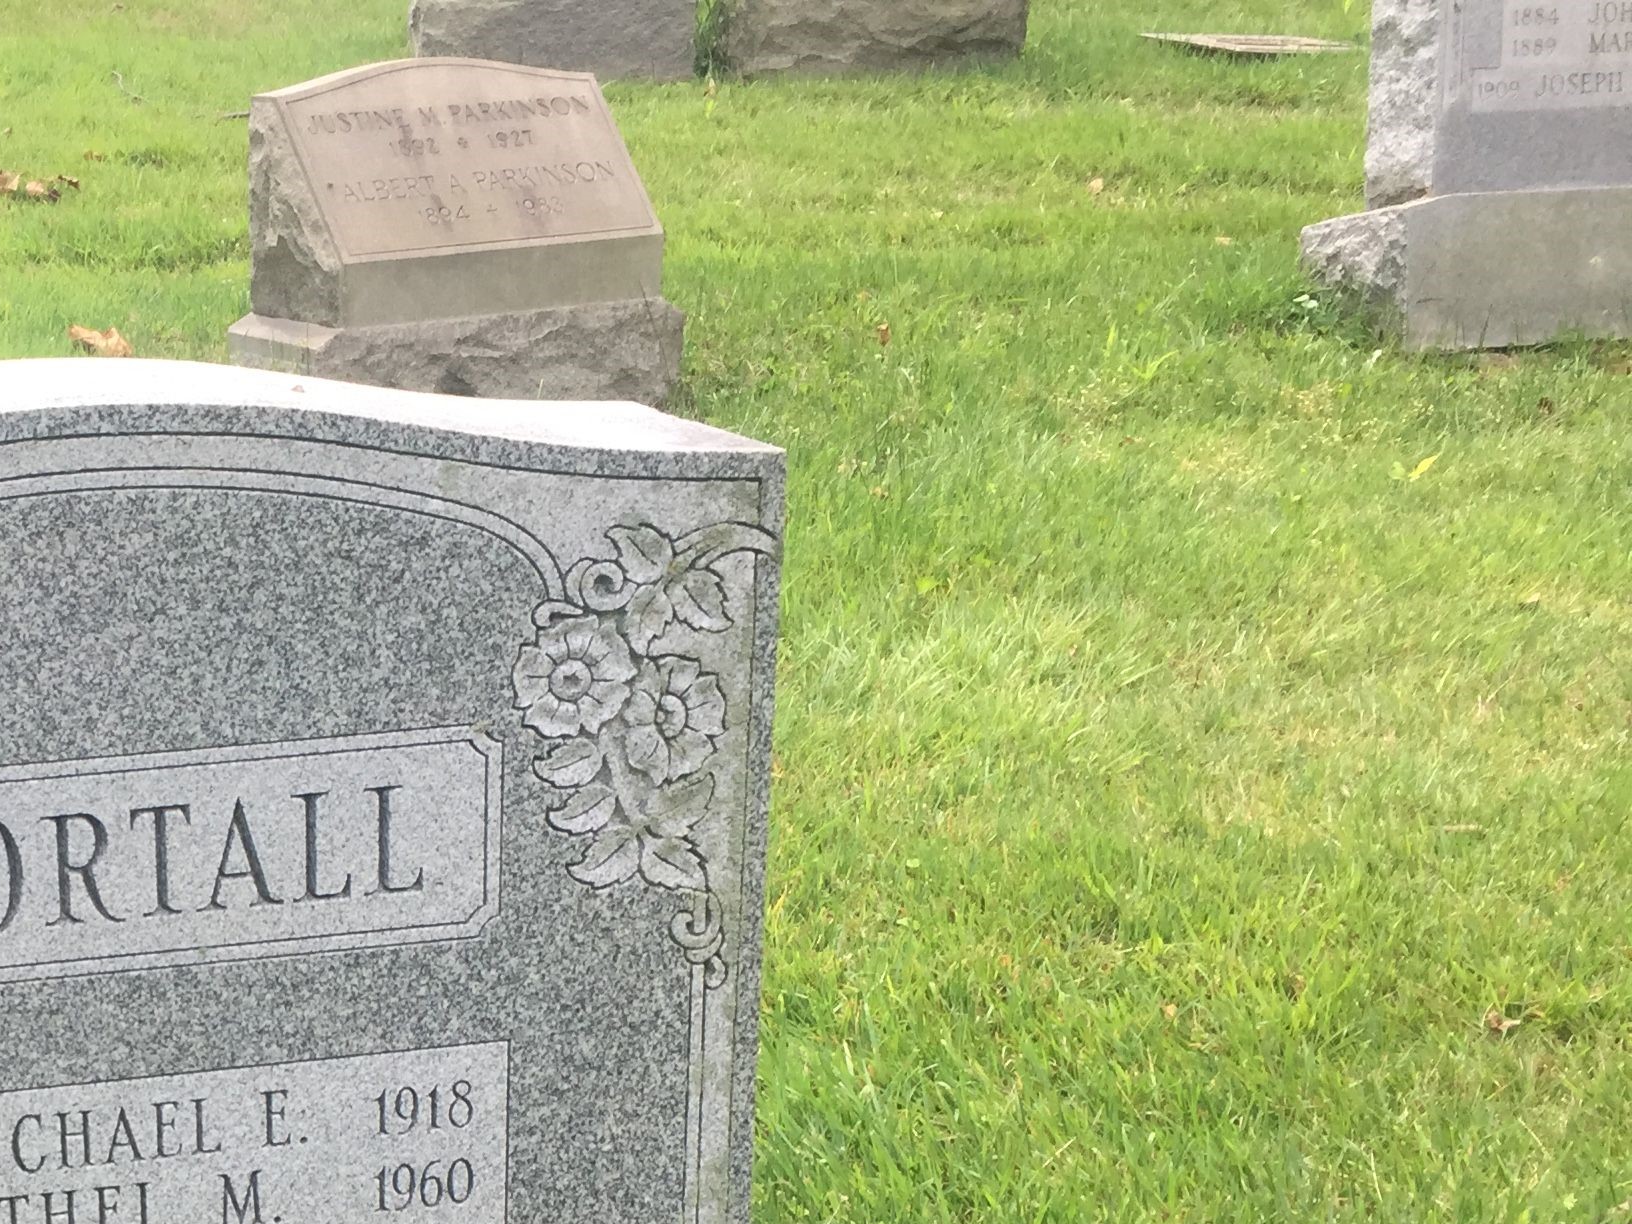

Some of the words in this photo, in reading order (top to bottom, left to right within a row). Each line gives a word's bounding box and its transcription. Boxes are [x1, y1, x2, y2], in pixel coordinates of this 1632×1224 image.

[1535, 71, 1624, 97] JOSEPH
[306, 108, 404, 136] JUSTINE
[448, 94, 590, 125] PARKINSON
[343, 174, 435, 203] ALBERT
[472, 160, 616, 191] PARKINSON
[261, 1088, 311, 1150] E.
[373, 1078, 475, 1138] 1918
[373, 1156, 476, 1215] 1960
